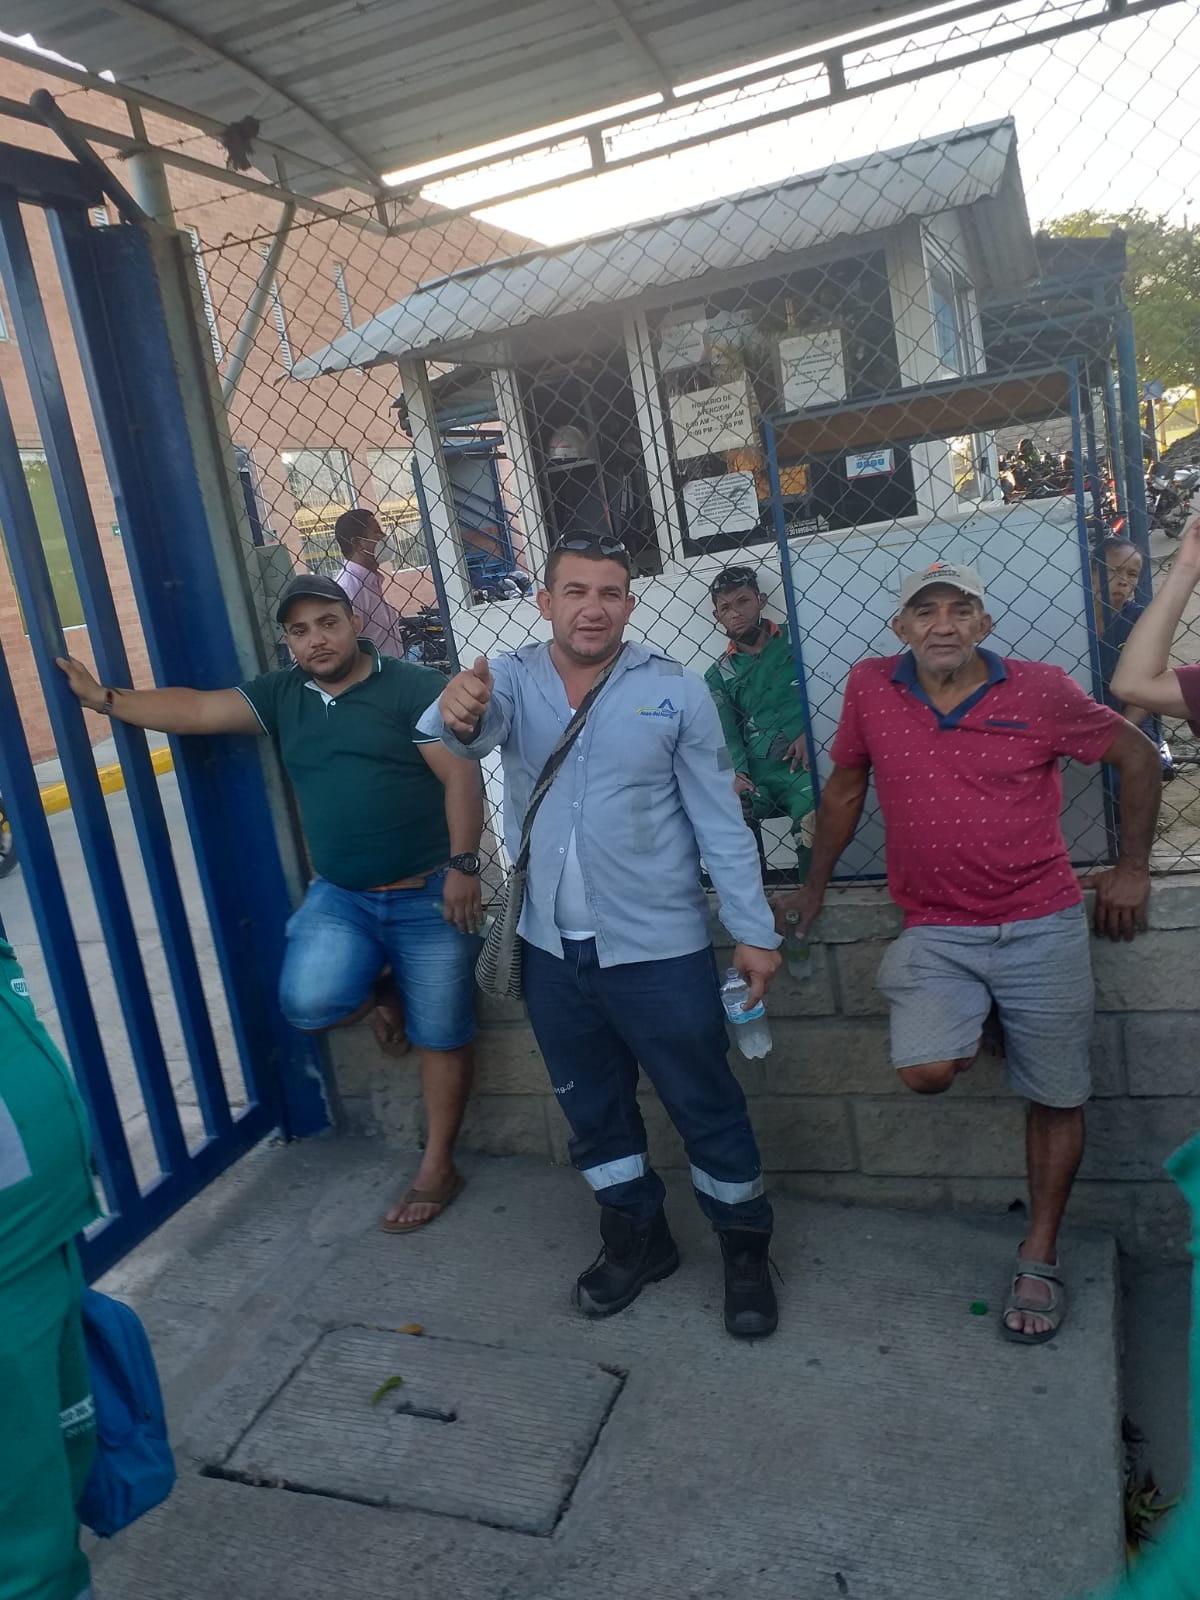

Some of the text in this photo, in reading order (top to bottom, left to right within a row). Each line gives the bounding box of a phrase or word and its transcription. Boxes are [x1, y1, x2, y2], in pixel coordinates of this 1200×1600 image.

[692, 397, 721, 409] HORARIO
[734, 409, 744, 417] AM
[703, 426, 713, 434] PM
[734, 419, 744, 427] PM
